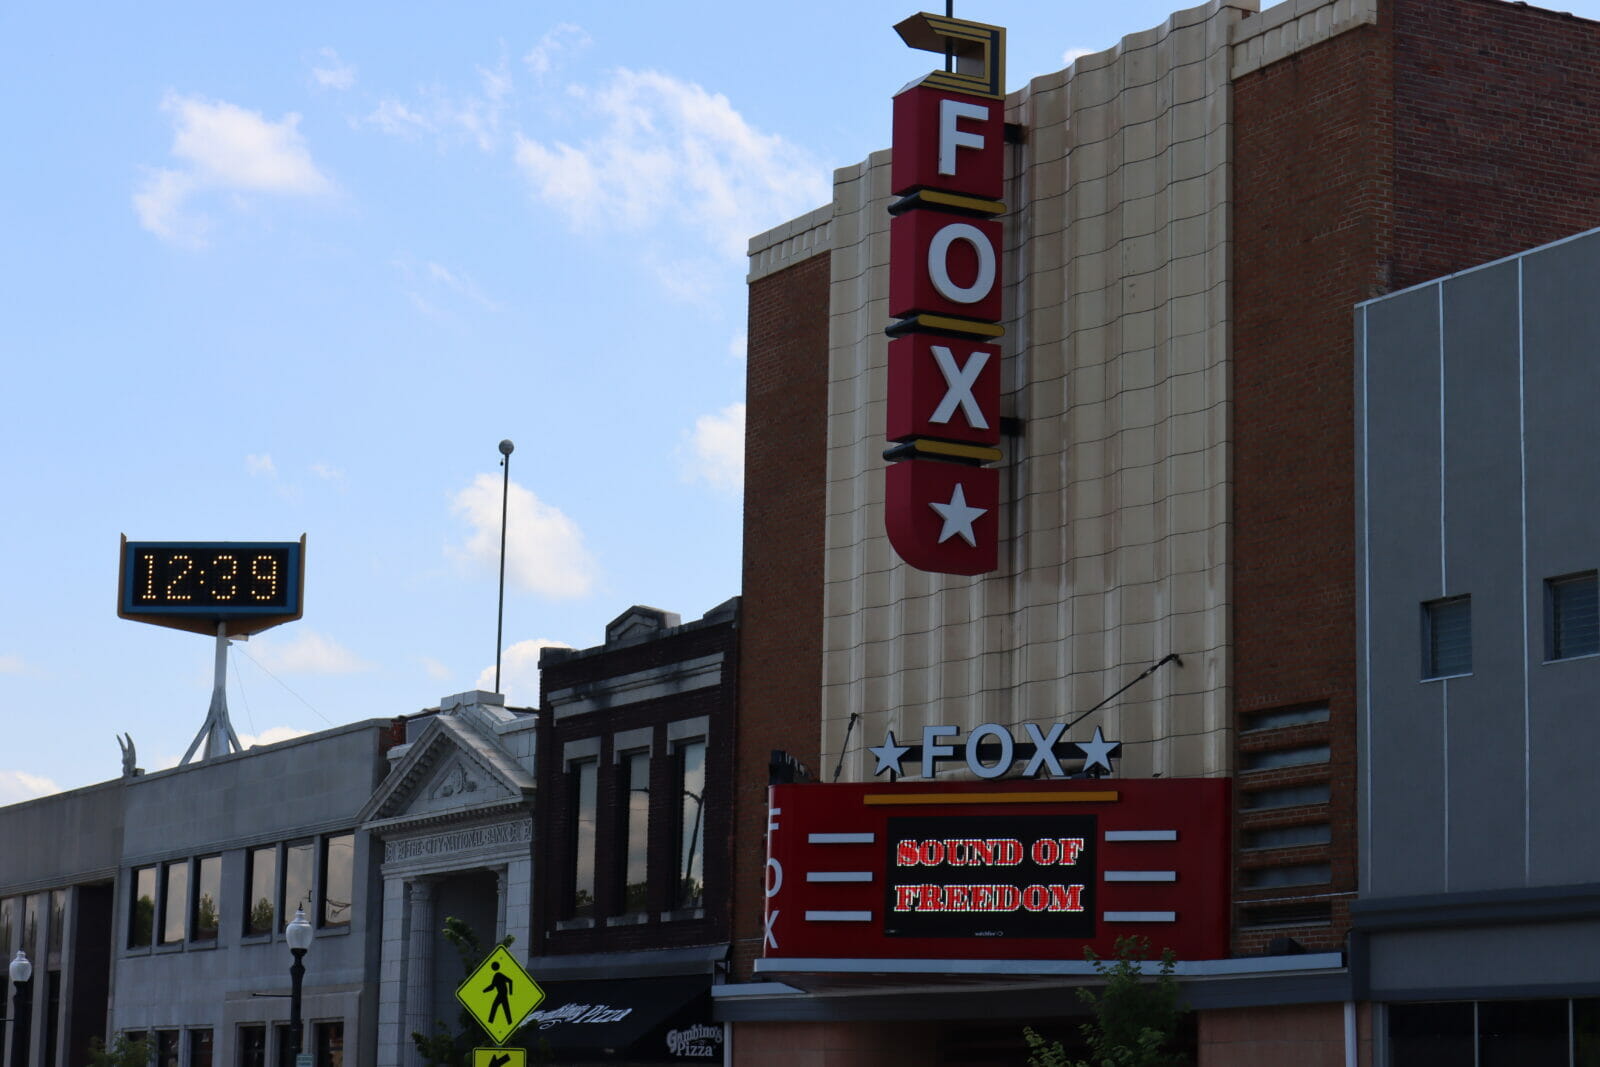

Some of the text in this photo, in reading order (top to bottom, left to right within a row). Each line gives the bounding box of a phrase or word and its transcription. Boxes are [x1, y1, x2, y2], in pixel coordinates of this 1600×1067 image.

[928, 99, 997, 430] FOX
[142, 555, 277, 599] 12:39
[921, 723, 1068, 779] FOX
[425, 836, 444, 855] CITY
[447, 830, 485, 852] NATIONAL
[487, 825, 509, 845] BANK
[896, 838, 1085, 867] SOUND OF
[893, 884, 1085, 912] FREEDOM
[666, 1023, 723, 1054] Gambino's
[676, 1041, 713, 1057] Pizza
